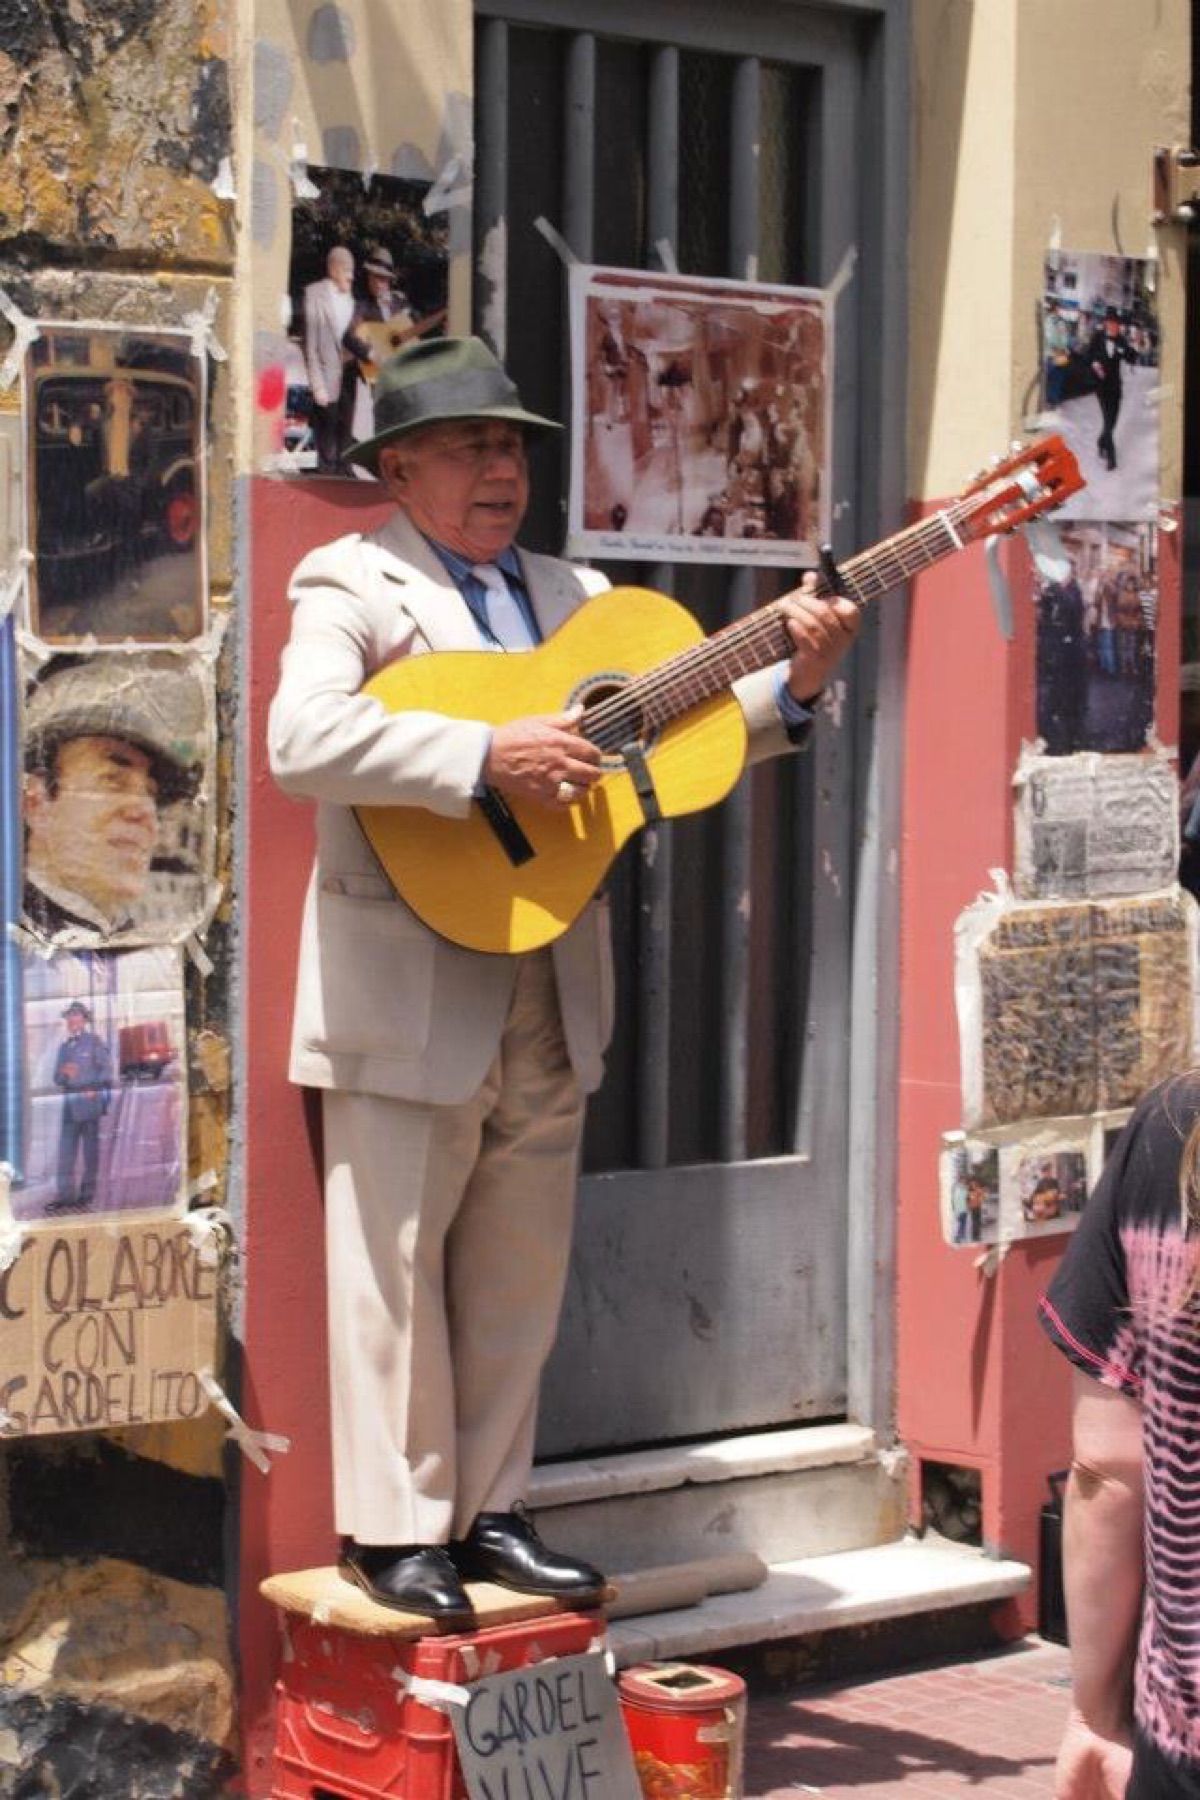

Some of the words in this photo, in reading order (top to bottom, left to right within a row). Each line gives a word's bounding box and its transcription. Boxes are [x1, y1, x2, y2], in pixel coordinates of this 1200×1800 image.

[0, 1232, 216, 1319] COLABORE
[43, 1310, 137, 1373] CON
[465, 1670, 603, 1757] GARDEL
